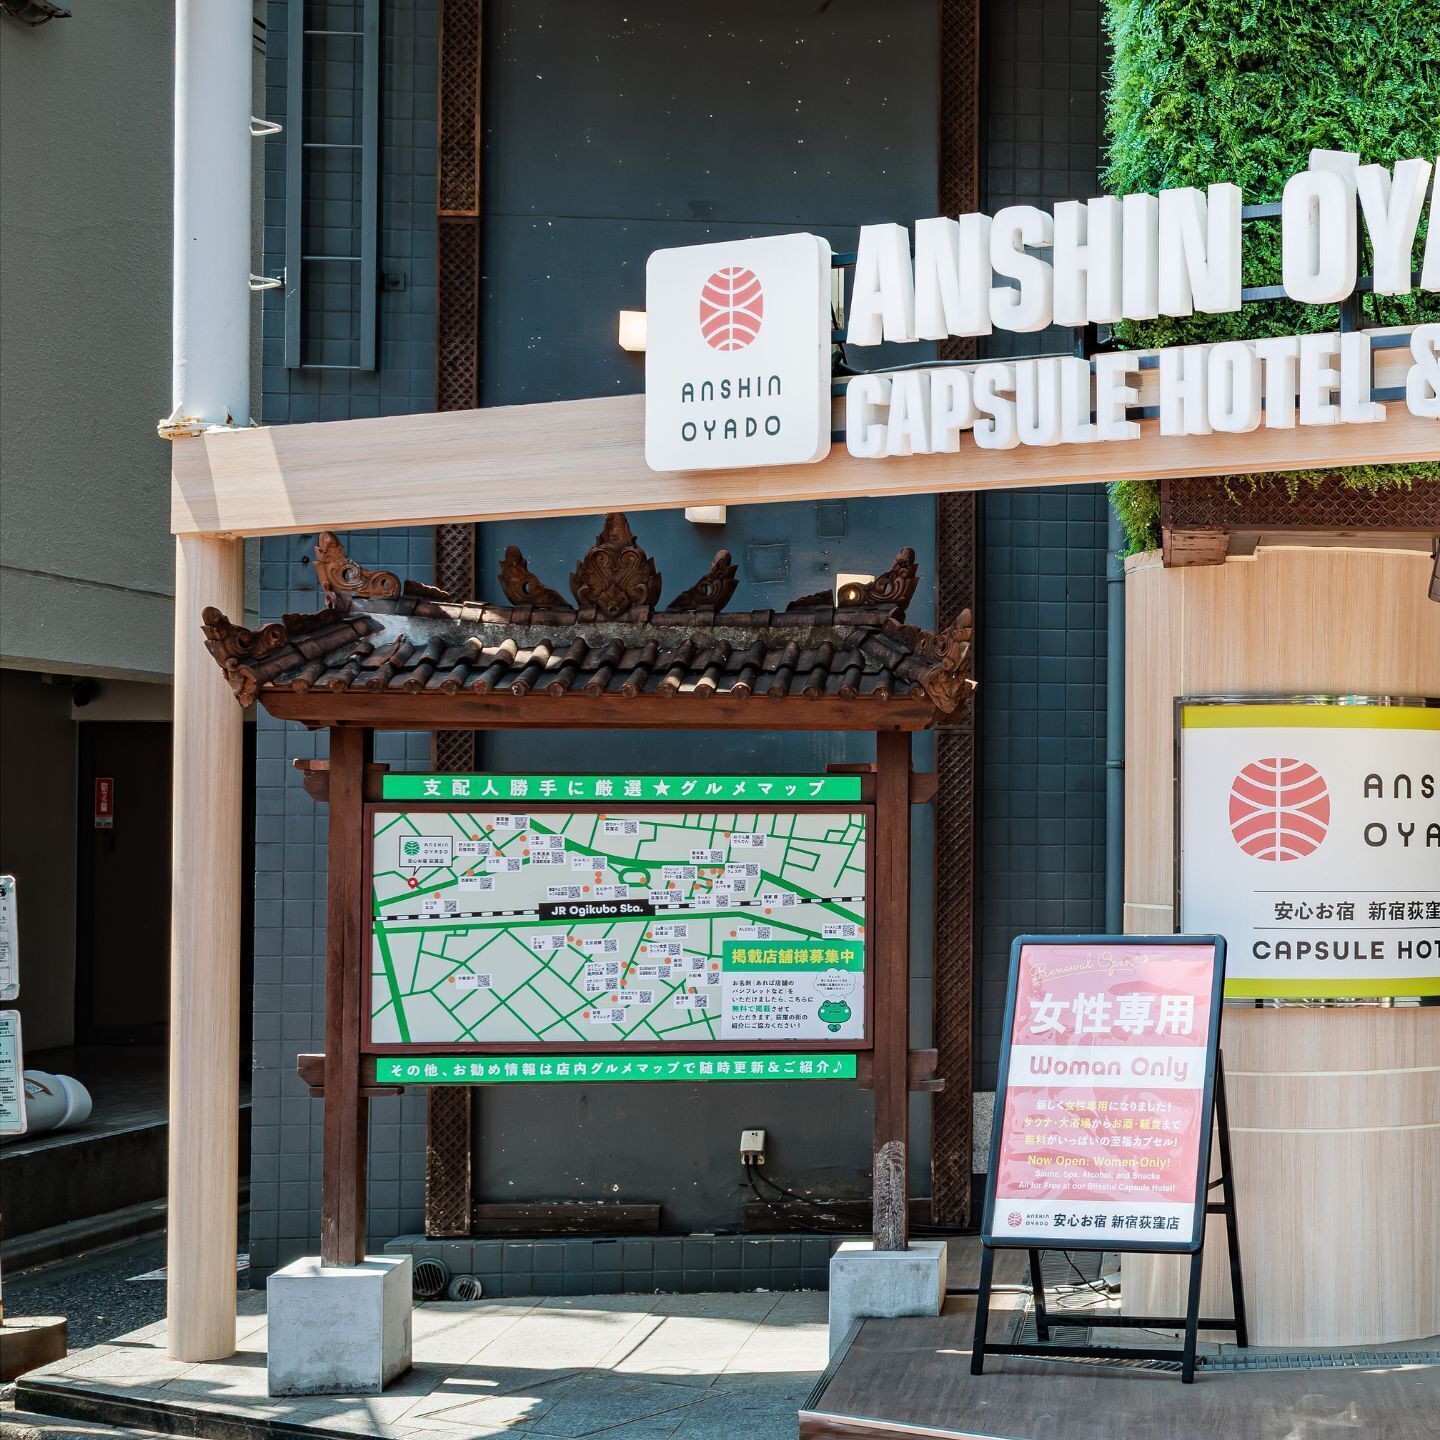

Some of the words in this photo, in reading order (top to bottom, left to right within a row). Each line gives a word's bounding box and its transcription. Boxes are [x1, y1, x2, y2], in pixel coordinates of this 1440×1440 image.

[847, 182, 1243, 346] ANSHIN
[681, 373, 784, 404] ANSHIN
[845, 352, 1141, 459] CAPSULE
[1157, 331, 1386, 436] HOTEL
[681, 415, 783, 443] OYADO
[551, 903, 566, 918] JR
[570, 899, 616, 920] Ogikubo
[620, 899, 644, 917] Sta.
[1274, 900, 1355, 921] 安心お宿
[732, 949, 854, 964] 掲載店舗様募集中
[1252, 940, 1385, 960] CAPSULE
[1030, 992, 1194, 1035] 女性専用
[1030, 1056, 1121, 1076] Woman
[1131, 1056, 1188, 1083] Only
[1028, 1155, 1052, 1165] Now
[1056, 1155, 1089, 1167] Open:
[1094, 1156, 1171, 1169] Women-Only!
[1044, 1181, 1061, 1189] Free
[1118, 1183, 1150, 1192] Capsule
[1053, 1213, 1106, 1227] 安心お宿
[1111, 1215, 1180, 1230] 新宿荻窪店
